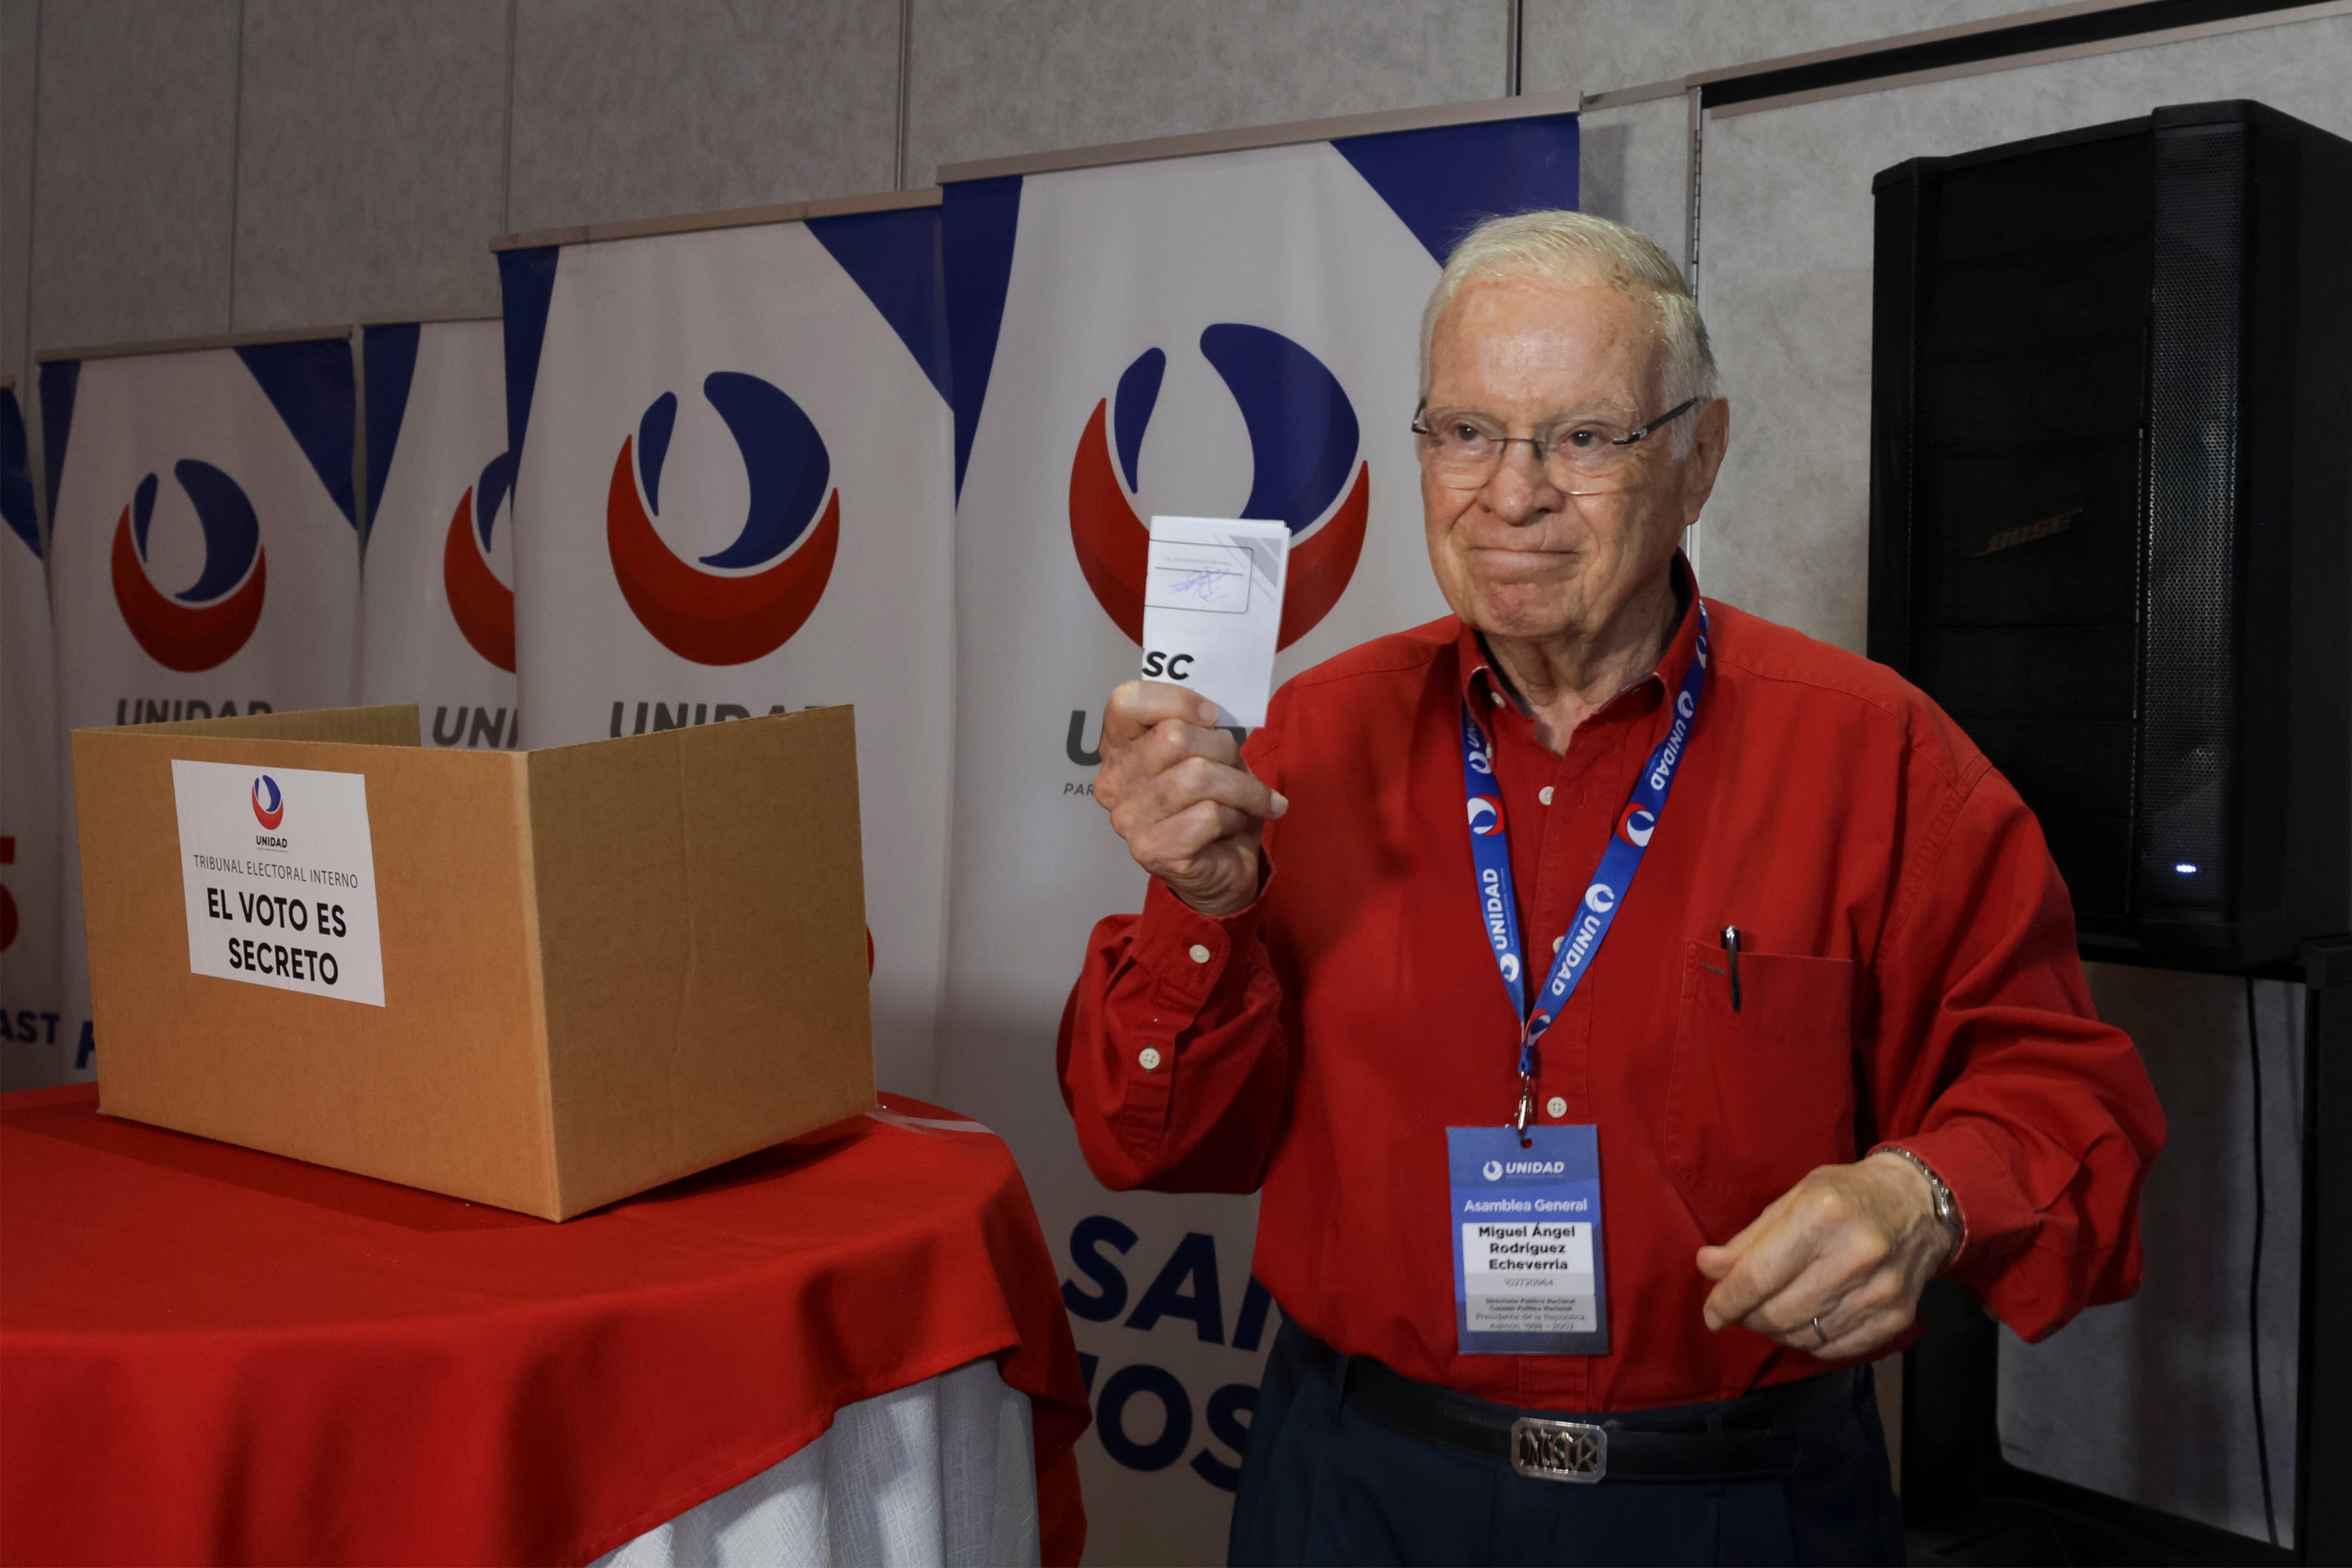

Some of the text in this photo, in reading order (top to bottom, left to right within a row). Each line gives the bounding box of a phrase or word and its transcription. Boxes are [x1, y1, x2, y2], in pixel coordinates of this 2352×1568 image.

[432, 706, 517, 748] UNI
[1650, 719, 1686, 791] UNIDAD
[1064, 783, 1094, 796] PAR
[256, 836, 287, 848] UNIDAD
[194, 855, 358, 889] TRIBUNAL ELECTORAL INTERNO
[207, 887, 346, 938] EL VOTO ES
[1482, 868, 1508, 950] UNIDAD
[229, 938, 338, 985] SECRETO
[1552, 915, 1601, 996] UNIDAD
[1505, 1162, 1565, 1175] UNIDAD
[1464, 1198, 1588, 1213] Asamblea General
[1478, 1222, 1575, 1239] Miguel Ángel
[1490, 1241, 1567, 1255] Rodríguez
